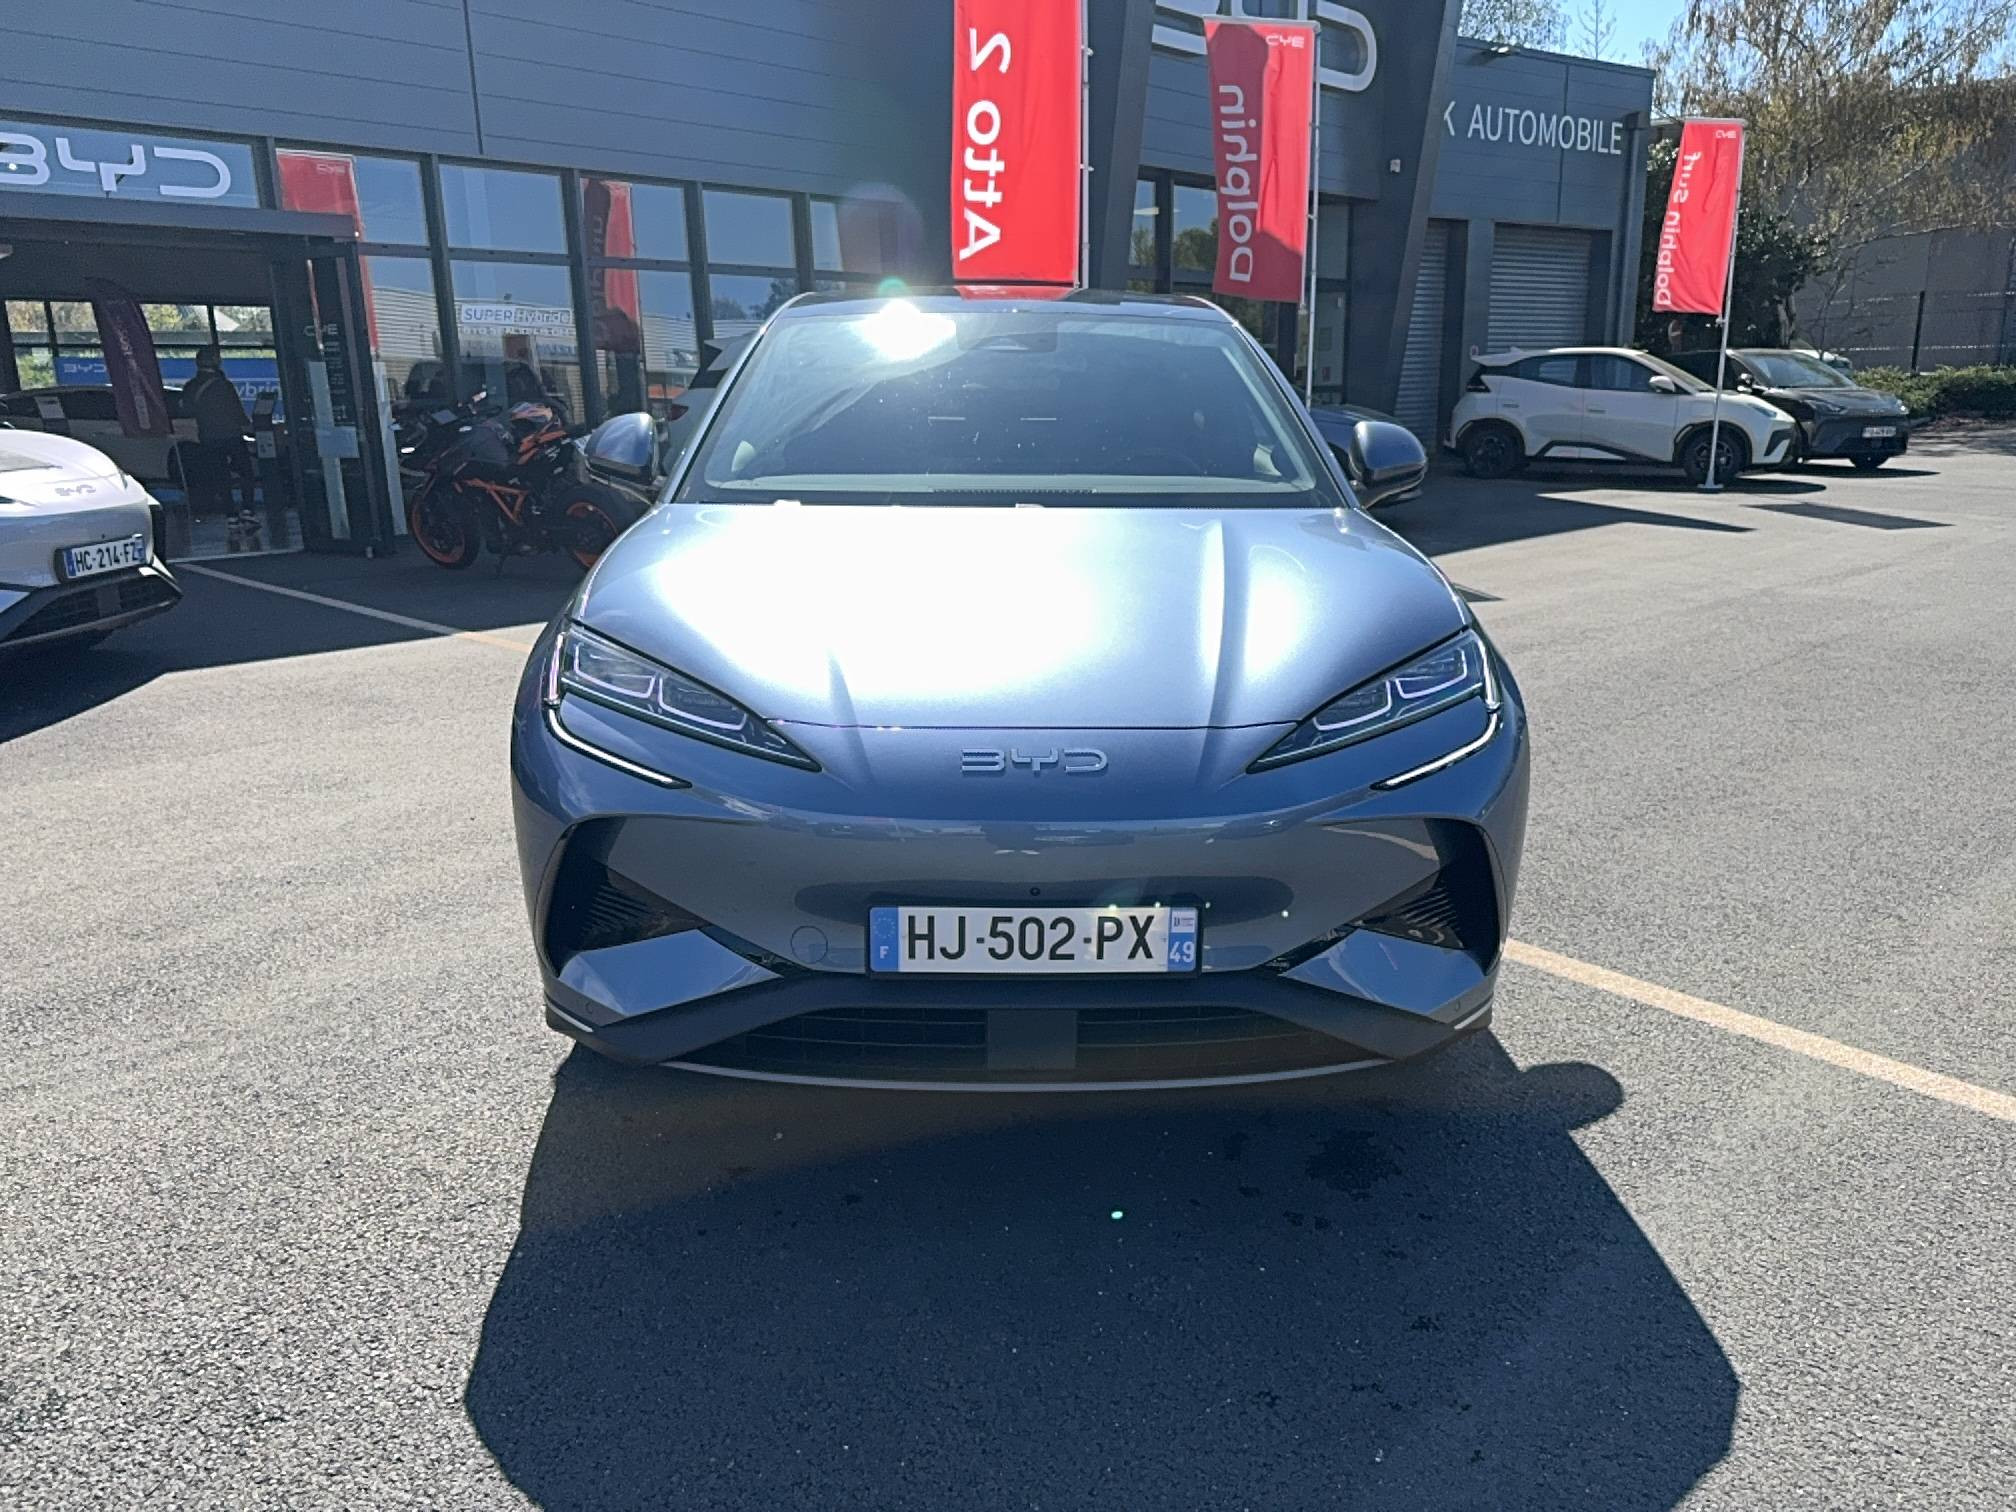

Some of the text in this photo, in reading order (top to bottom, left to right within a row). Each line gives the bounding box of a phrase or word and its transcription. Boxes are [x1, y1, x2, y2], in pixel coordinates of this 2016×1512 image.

[1467, 103, 1623, 155] AUTOMOBILE
[463, 307, 513, 321] SUPER
[962, 748, 1107, 772] BYD
[907, 915, 1155, 961] HJ-502-PX
[879, 946, 888, 959] F
[1169, 940, 1195, 963] 49
